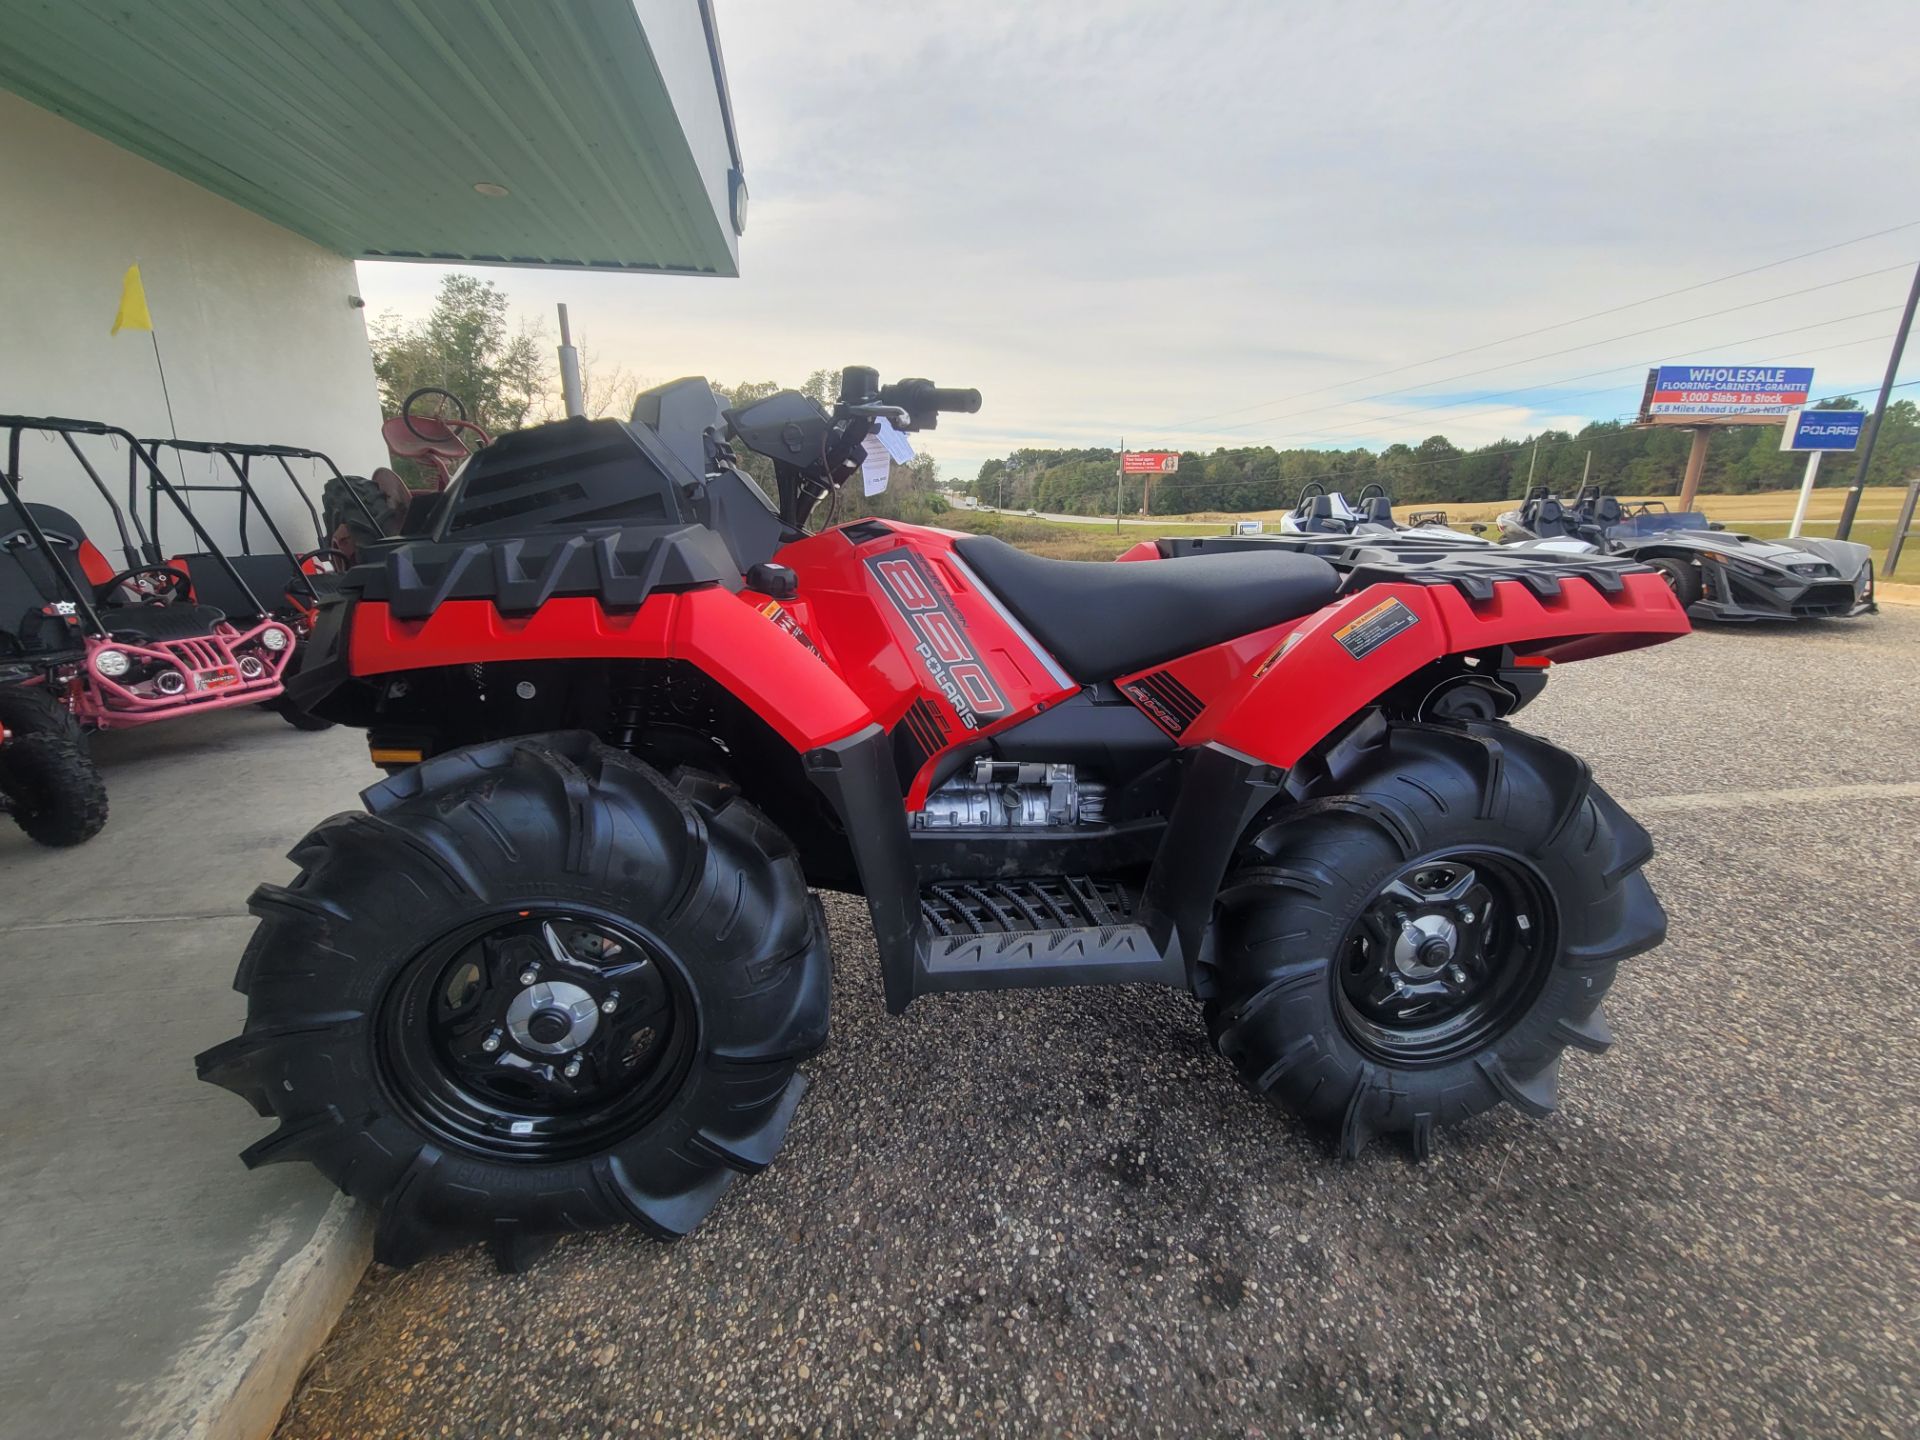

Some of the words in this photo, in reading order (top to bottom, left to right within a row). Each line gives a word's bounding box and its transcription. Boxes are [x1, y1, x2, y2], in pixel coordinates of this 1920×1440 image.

[1689, 368, 1786, 382] WHOLESALE
[1662, 381, 1807, 391] FLOORING-CABINETS-GRANITE
[1680, 392, 1709, 402] 3,000
[1711, 392, 1738, 402] Slabs
[1740, 393, 1752, 402] In
[1754, 393, 1783, 403] Stock
[1672, 404, 1696, 413] Miles
[1698, 405, 1726, 413] Ahead
[1729, 405, 1747, 414] Left
[1799, 425, 1860, 436] POLARIS
[914, 552, 969, 629] SPORTSMAN
[877, 559, 1005, 714] 850
[915, 642, 978, 730] POLARIS
[1127, 686, 1181, 731] AWD
